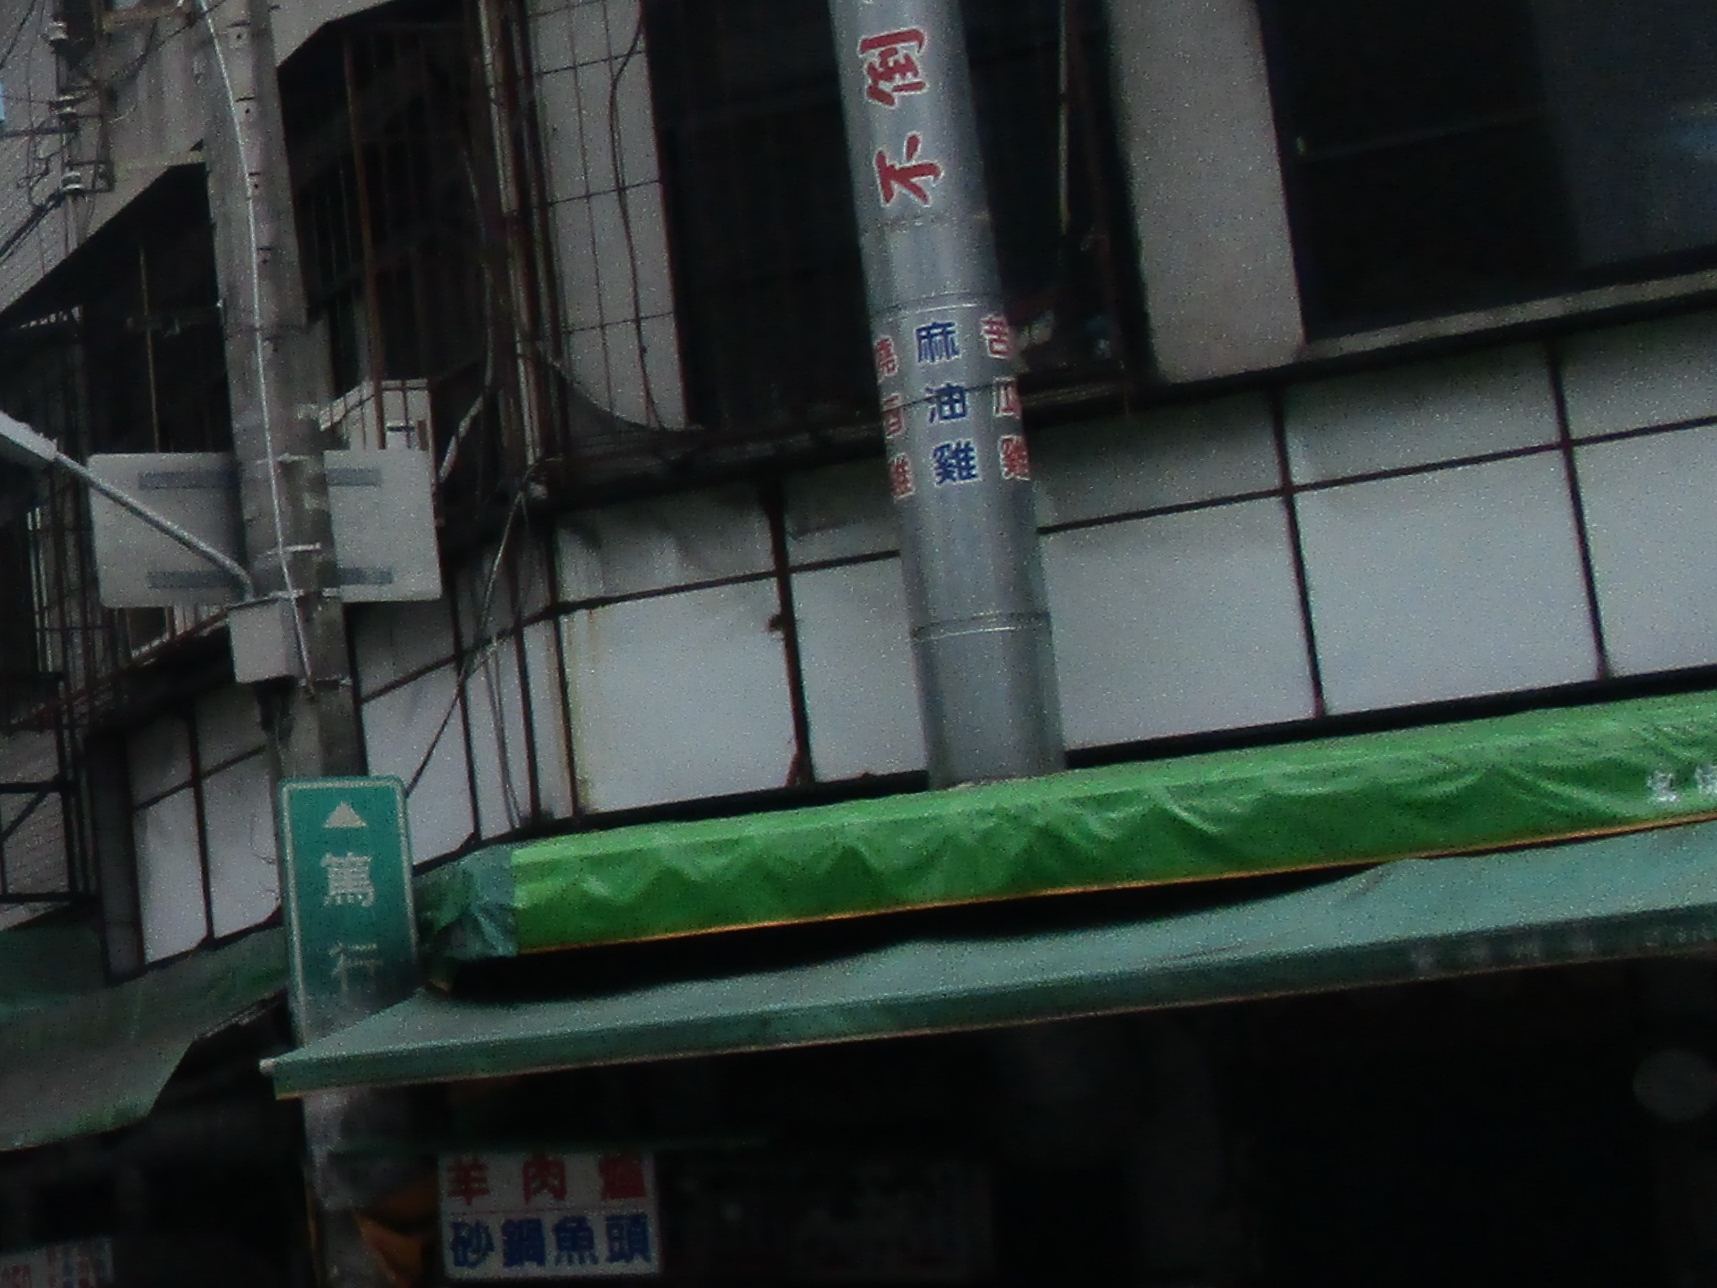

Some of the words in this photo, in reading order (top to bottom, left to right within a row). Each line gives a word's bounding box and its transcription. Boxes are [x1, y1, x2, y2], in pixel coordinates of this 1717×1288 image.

[914, 321, 981, 488] 麻油雞
[449, 1212, 653, 1269] 砂鍋魚頭
